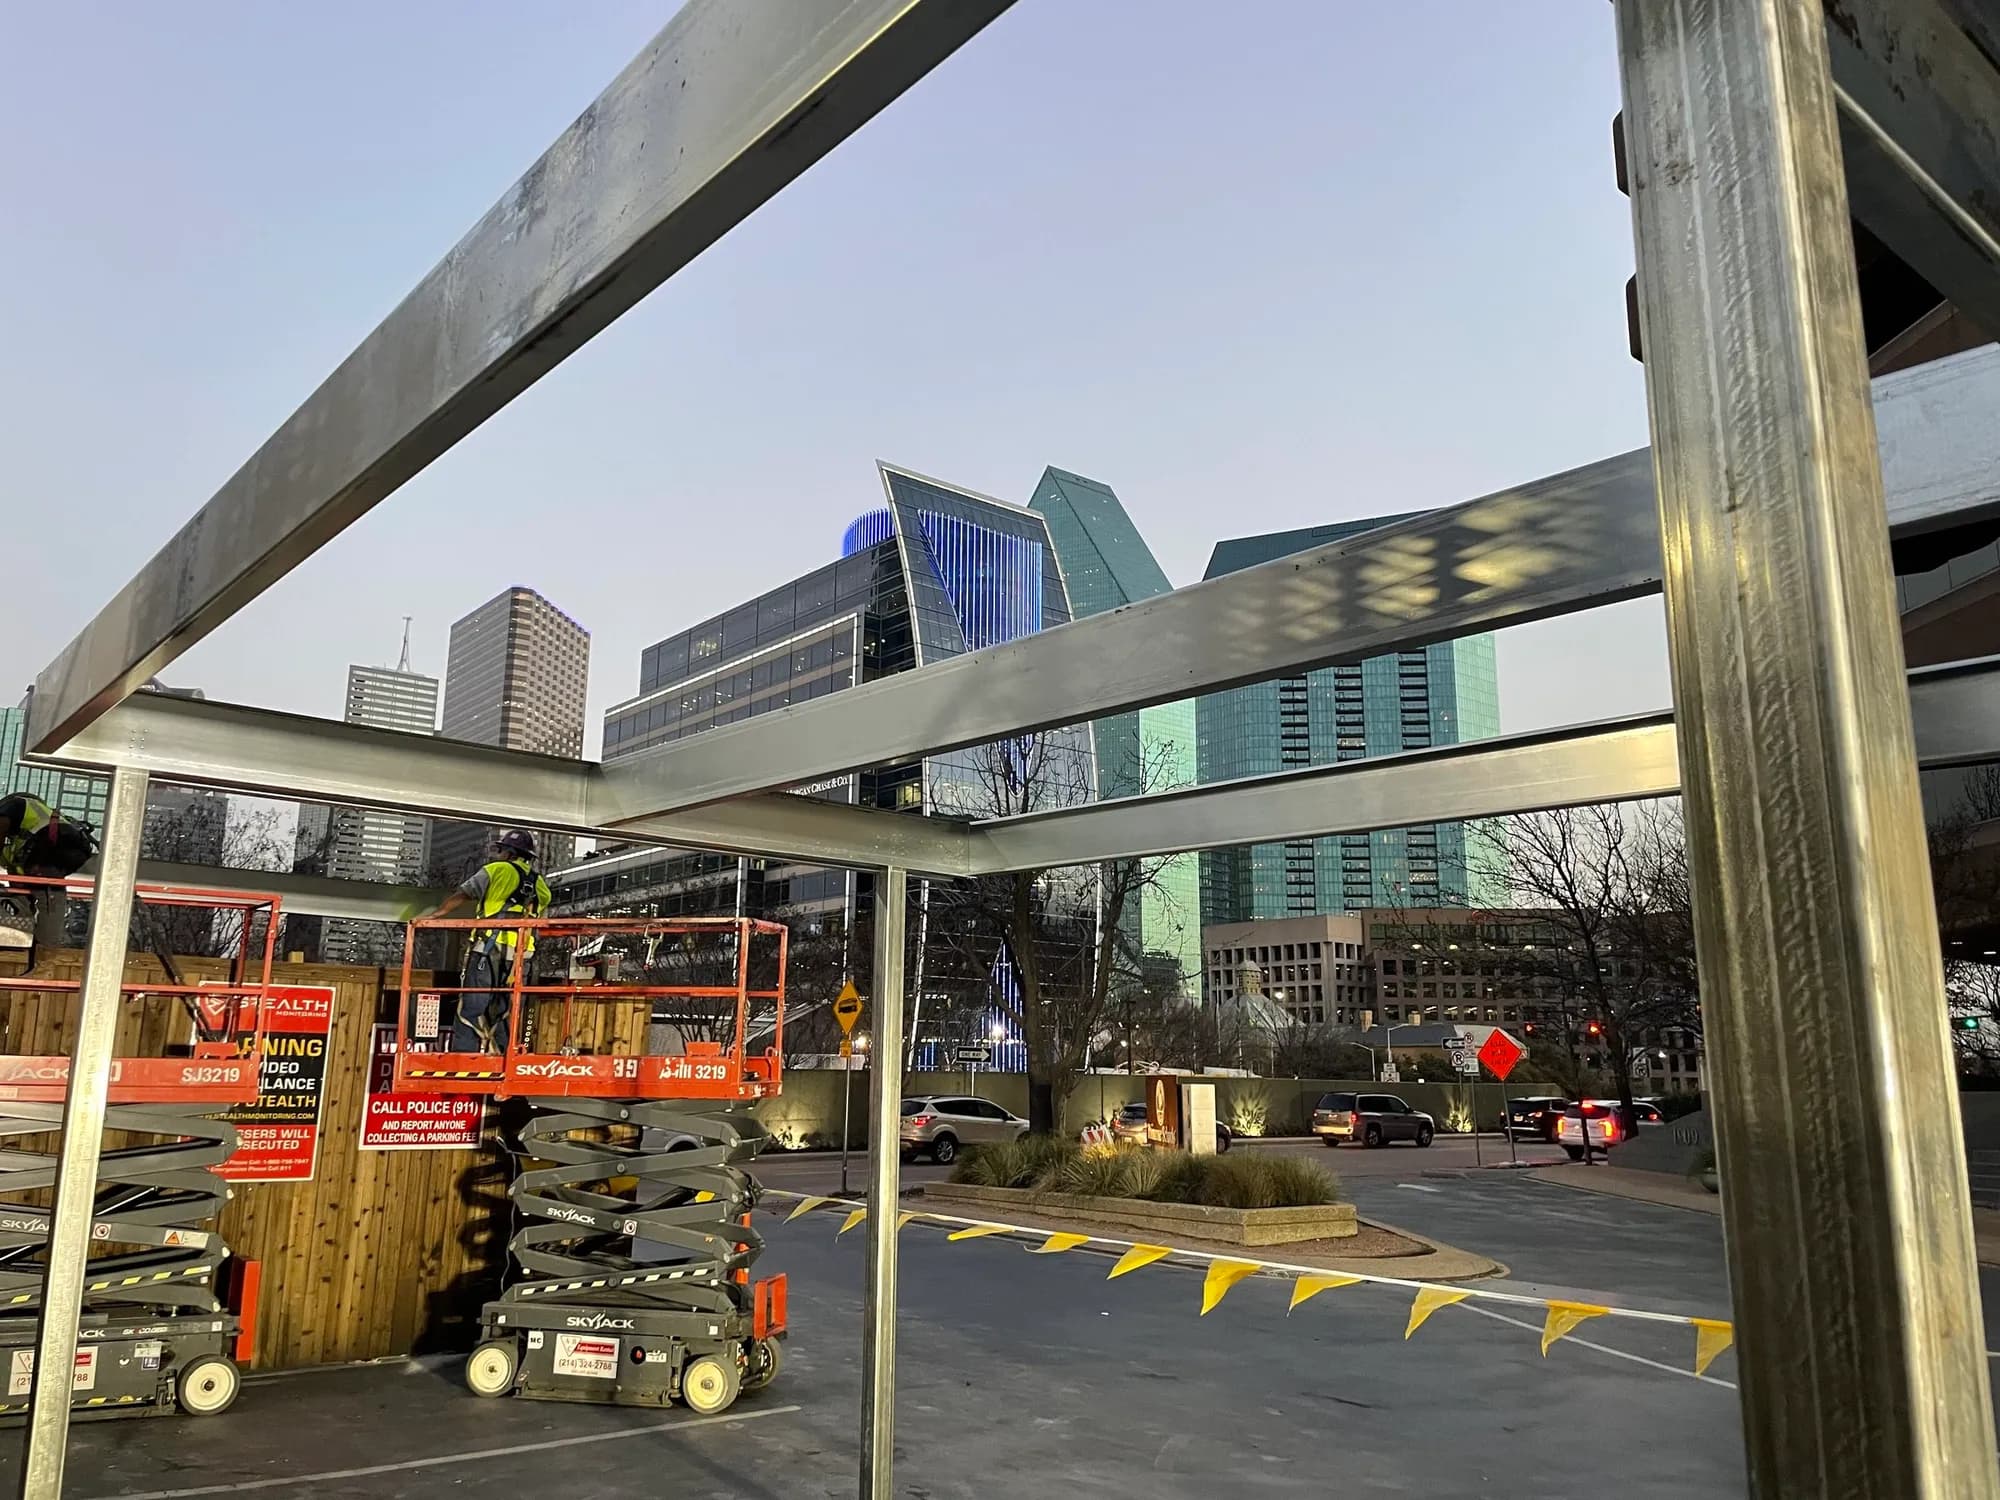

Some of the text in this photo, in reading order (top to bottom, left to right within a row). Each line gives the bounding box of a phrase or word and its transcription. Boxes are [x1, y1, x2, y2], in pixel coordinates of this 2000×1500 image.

[275, 1010, 328, 1018] MONITORING
[235, 1037, 323, 1057] RNING
[182, 1067, 240, 1082] SJ3219
[516, 1060, 593, 1078] SKYJACK
[695, 1065, 726, 1080] 3219
[372, 1100, 479, 1117] CALL POLICE (911)
[382, 1120, 466, 1130] AND REPORT ANYONE
[280, 1129, 311, 1139] WILL
[367, 1132, 477, 1143] COLLECTING A PARKING FEE
[546, 1207, 595, 1225] SKYJACK
[1, 1218, 49, 1232] SKYJA
[566, 1313, 634, 1329] SKYJACK
[559, 1358, 577, 1369] (214)
[16, 1378, 31, 1387] (21
